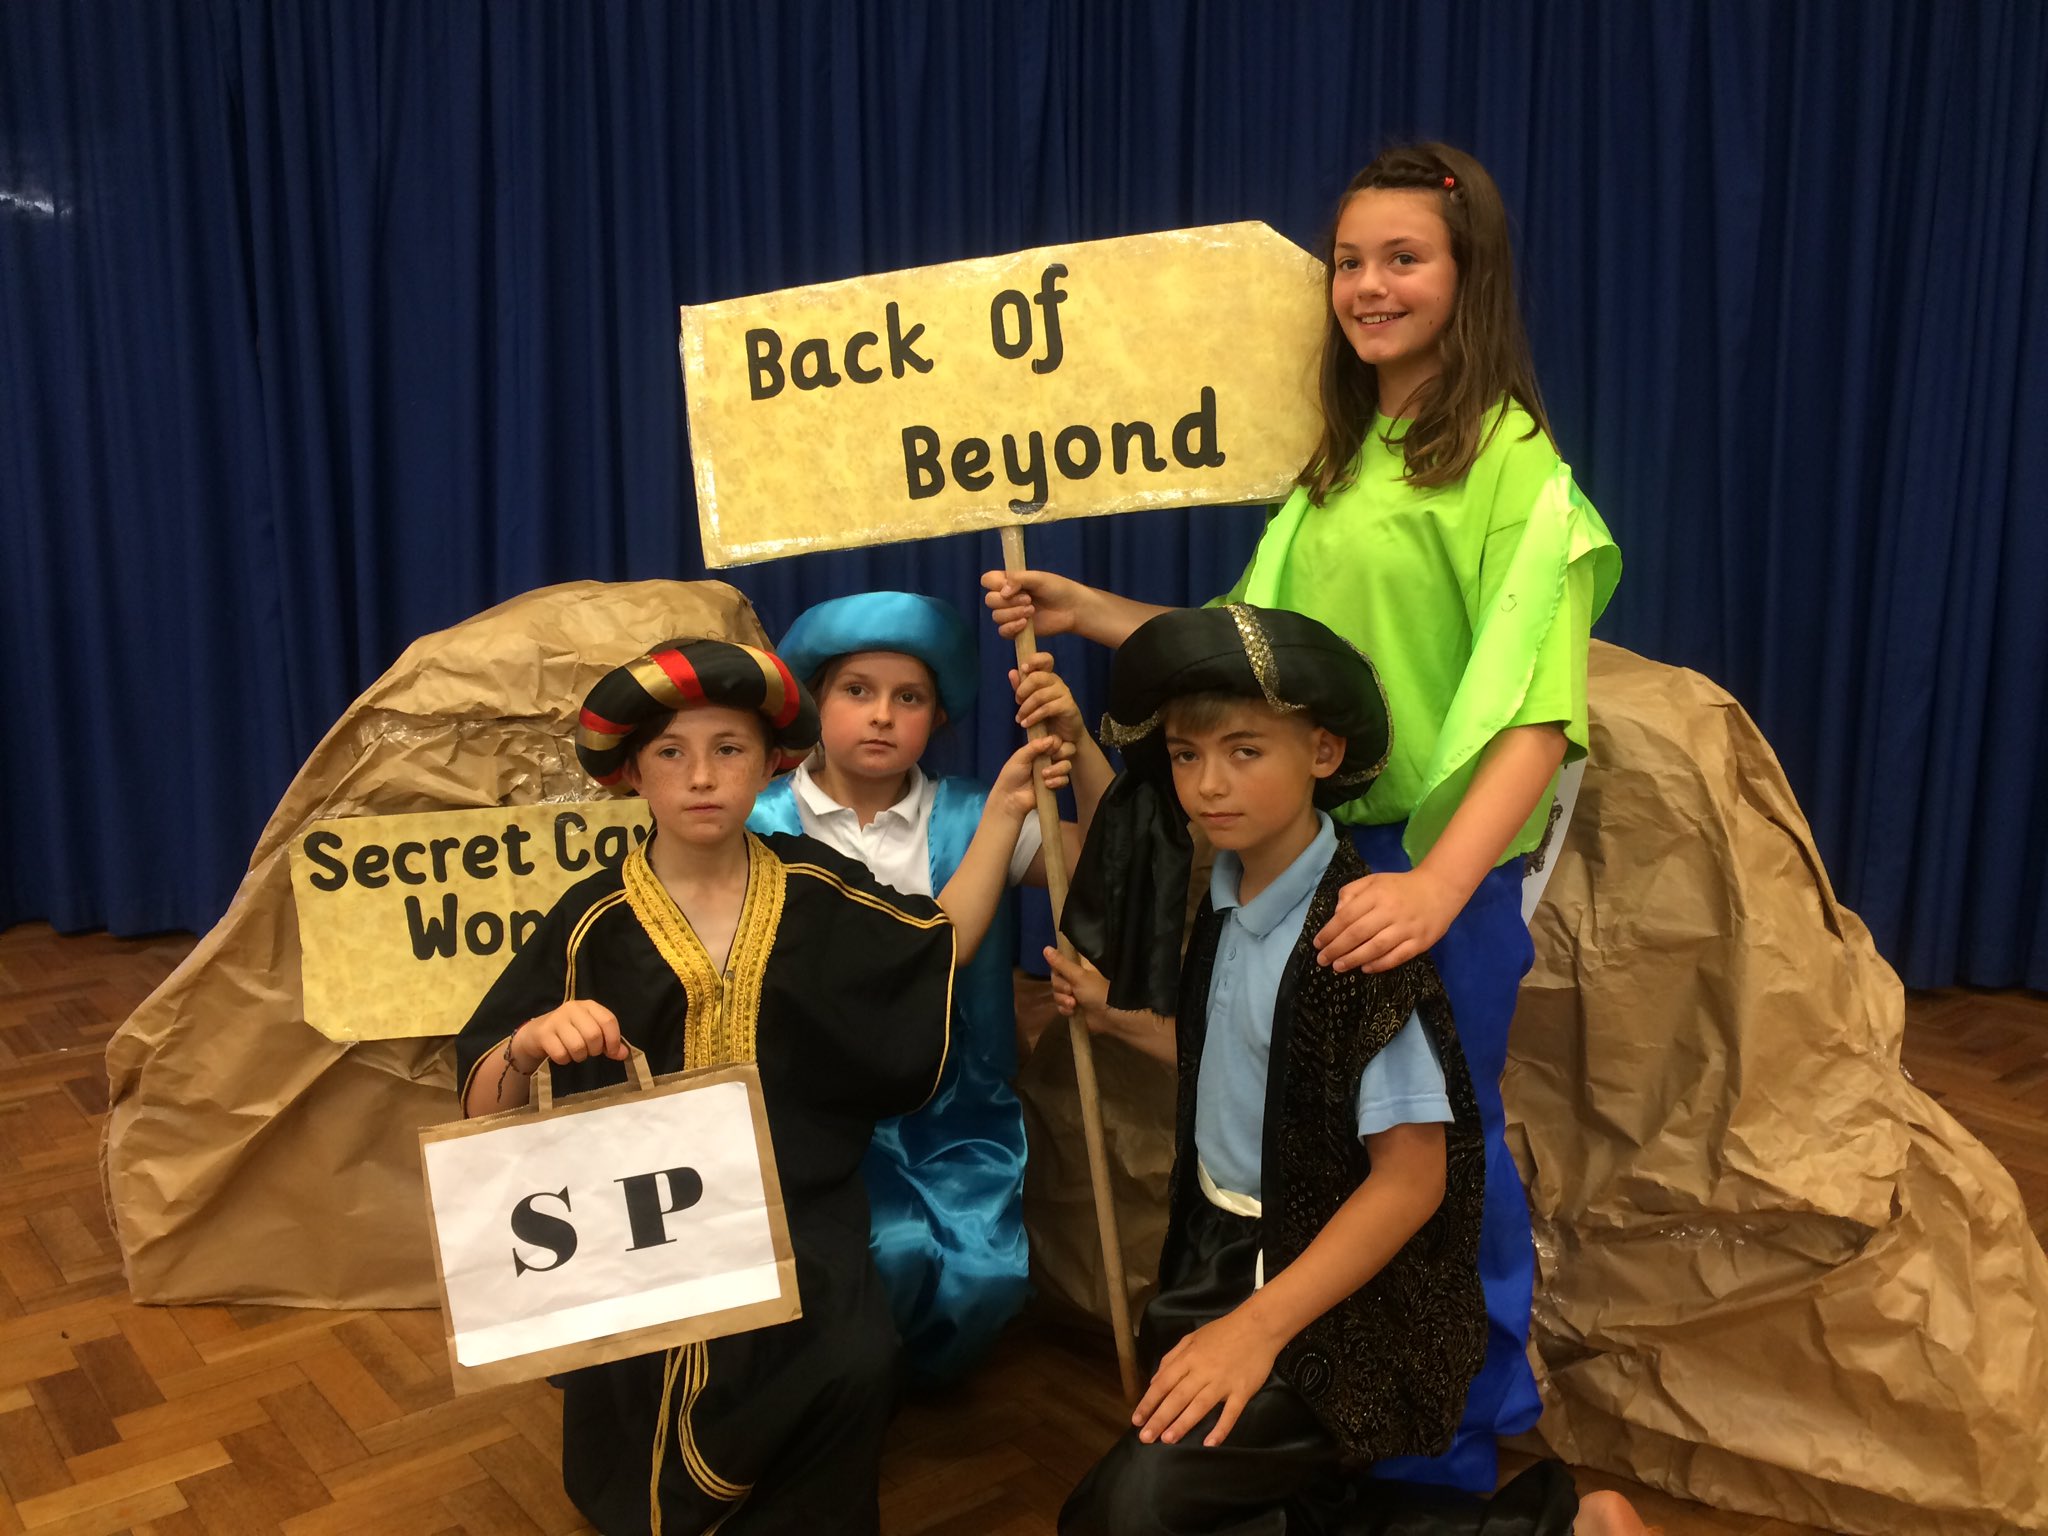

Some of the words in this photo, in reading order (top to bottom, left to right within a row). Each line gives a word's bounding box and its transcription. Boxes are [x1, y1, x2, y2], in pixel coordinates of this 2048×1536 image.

[745, 301, 934, 400] Back
[990, 263, 1069, 374] Of
[901, 386, 1226, 515] Beyond
[303, 823, 535, 891] Secret
